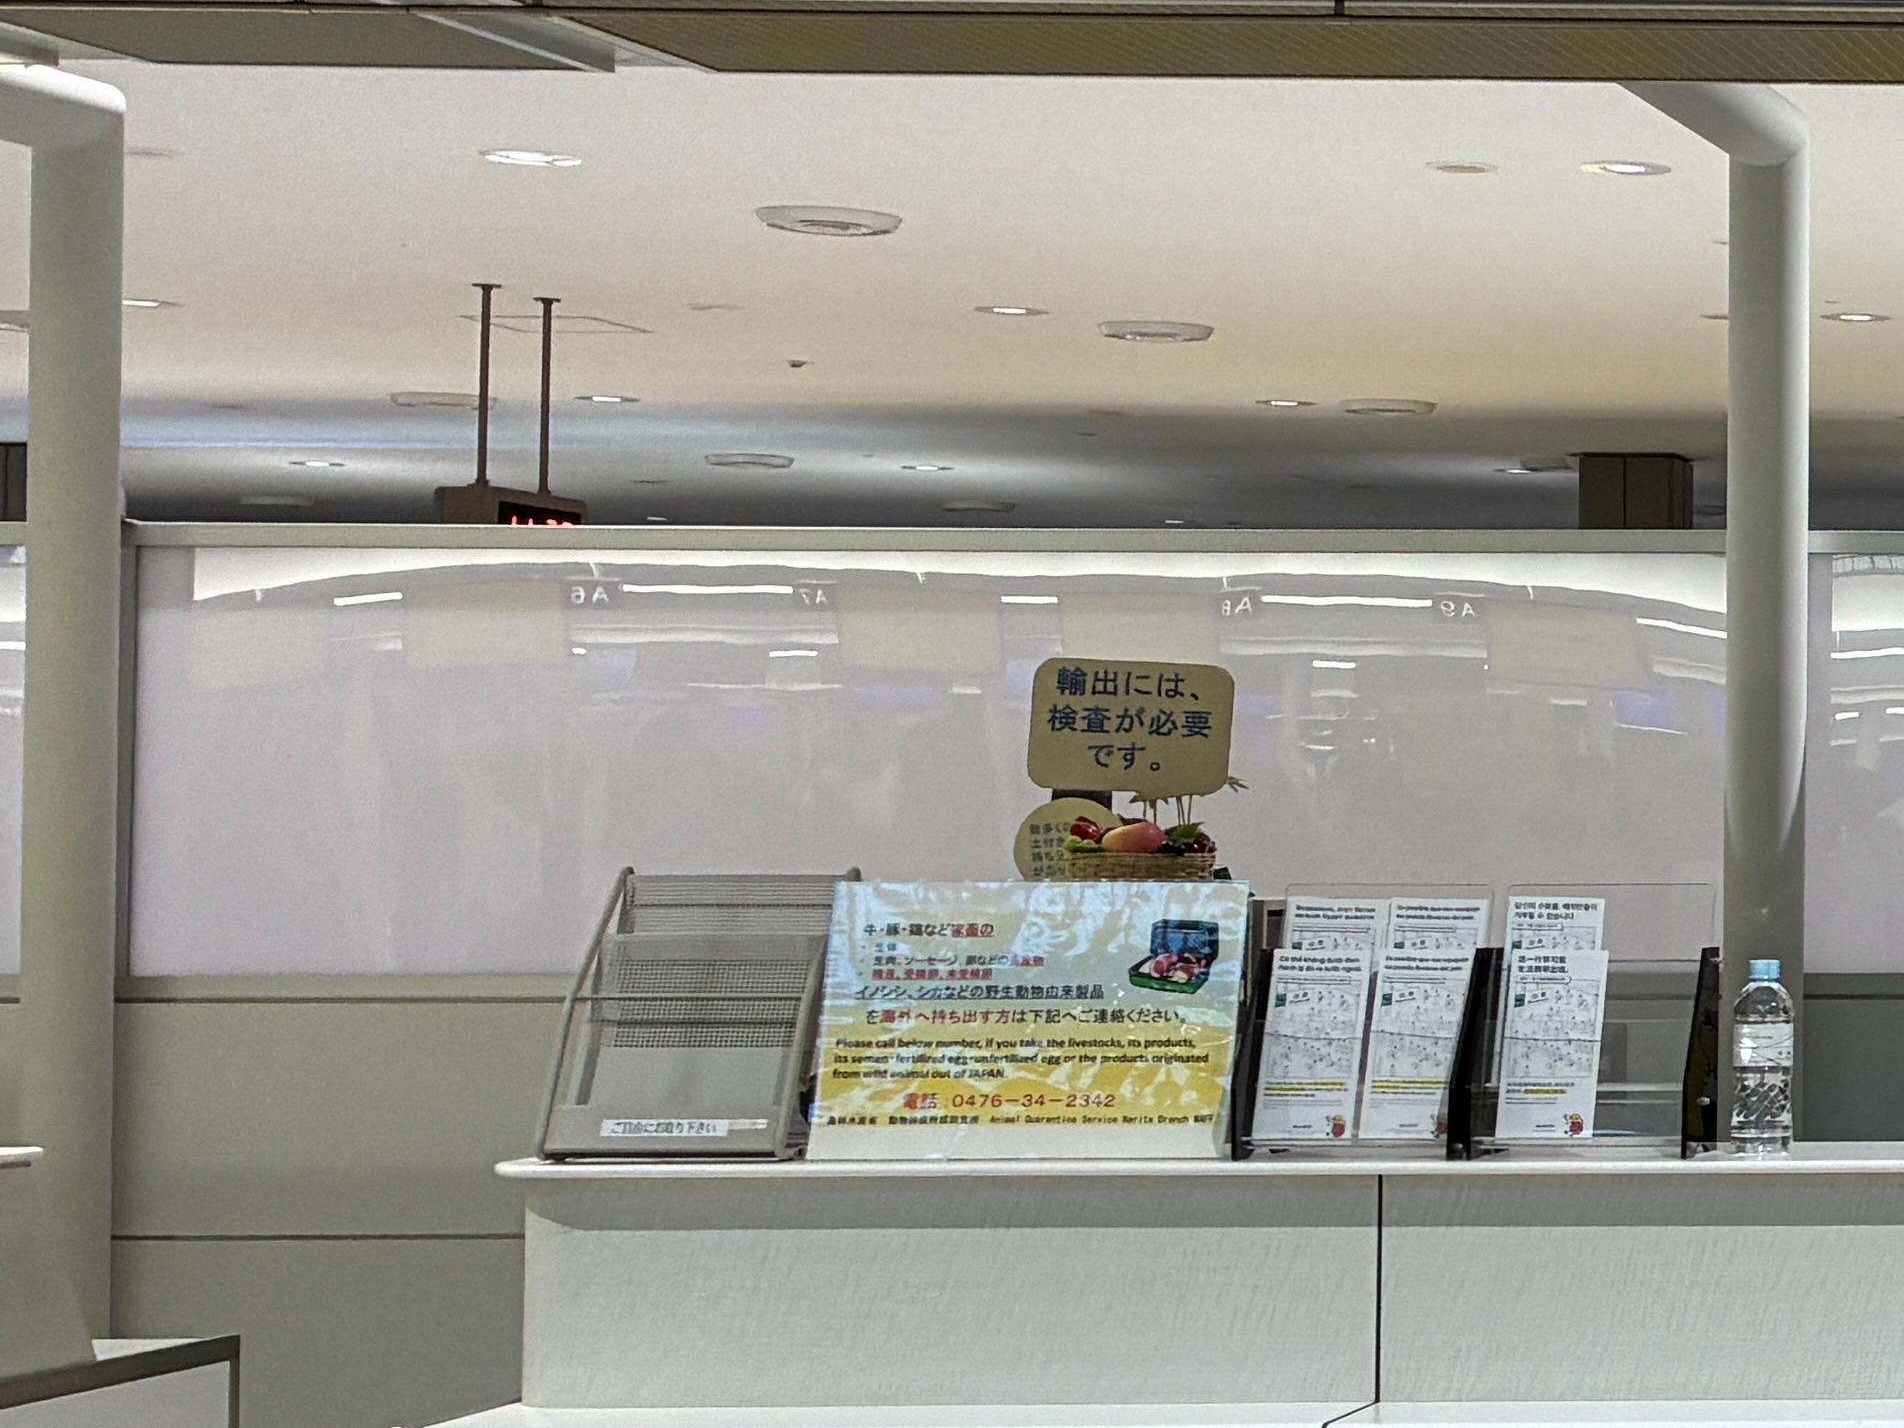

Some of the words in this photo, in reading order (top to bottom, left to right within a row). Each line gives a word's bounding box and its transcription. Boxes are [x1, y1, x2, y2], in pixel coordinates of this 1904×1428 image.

[1056, 666, 1200, 701] 輸出には、
[1047, 704, 1213, 739] 検査が必要
[1088, 743, 1163, 772] です。
[904, 1092, 939, 1110] 電話
